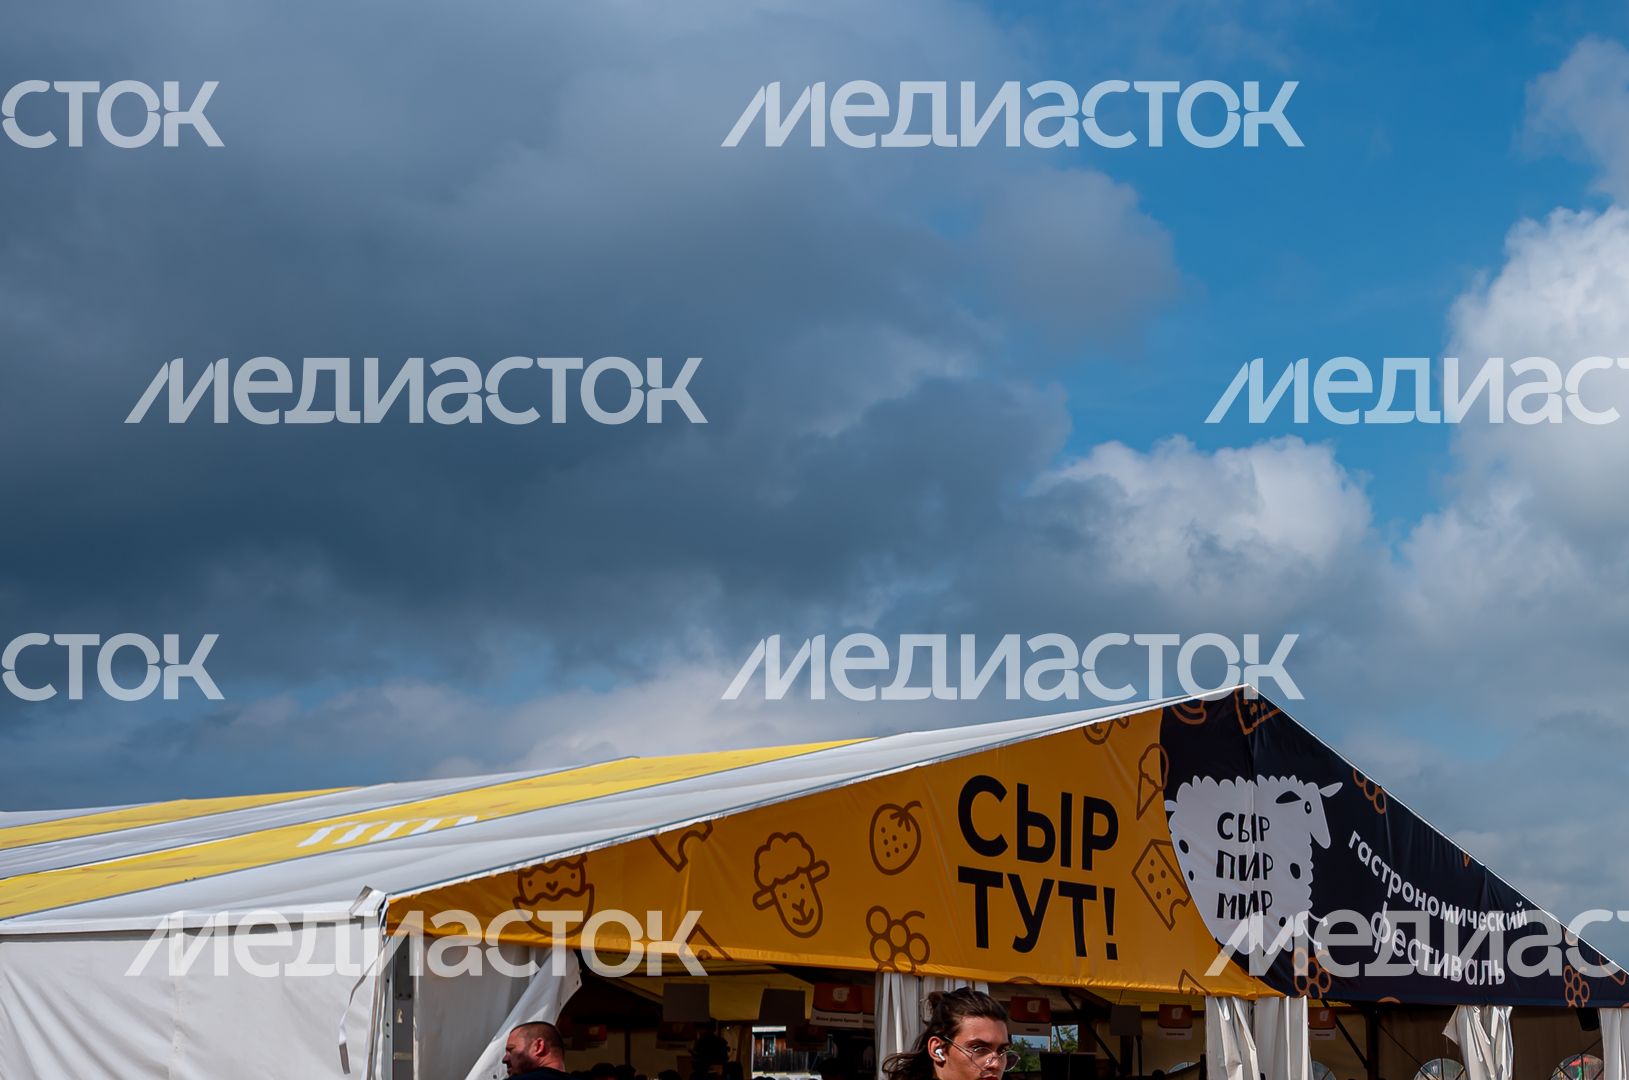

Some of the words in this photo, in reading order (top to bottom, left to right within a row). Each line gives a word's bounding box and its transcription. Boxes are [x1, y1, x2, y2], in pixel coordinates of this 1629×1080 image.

[957, 774, 1119, 871] СЫР
[1217, 812, 1270, 843] СЫР
[1216, 850, 1273, 881] ПИР
[1217, 890, 1272, 920] МИР
[1348, 830, 1527, 932] гастрономический
[957, 865, 1119, 960] ТУТ!
[1370, 901, 1506, 986] фестиваль
